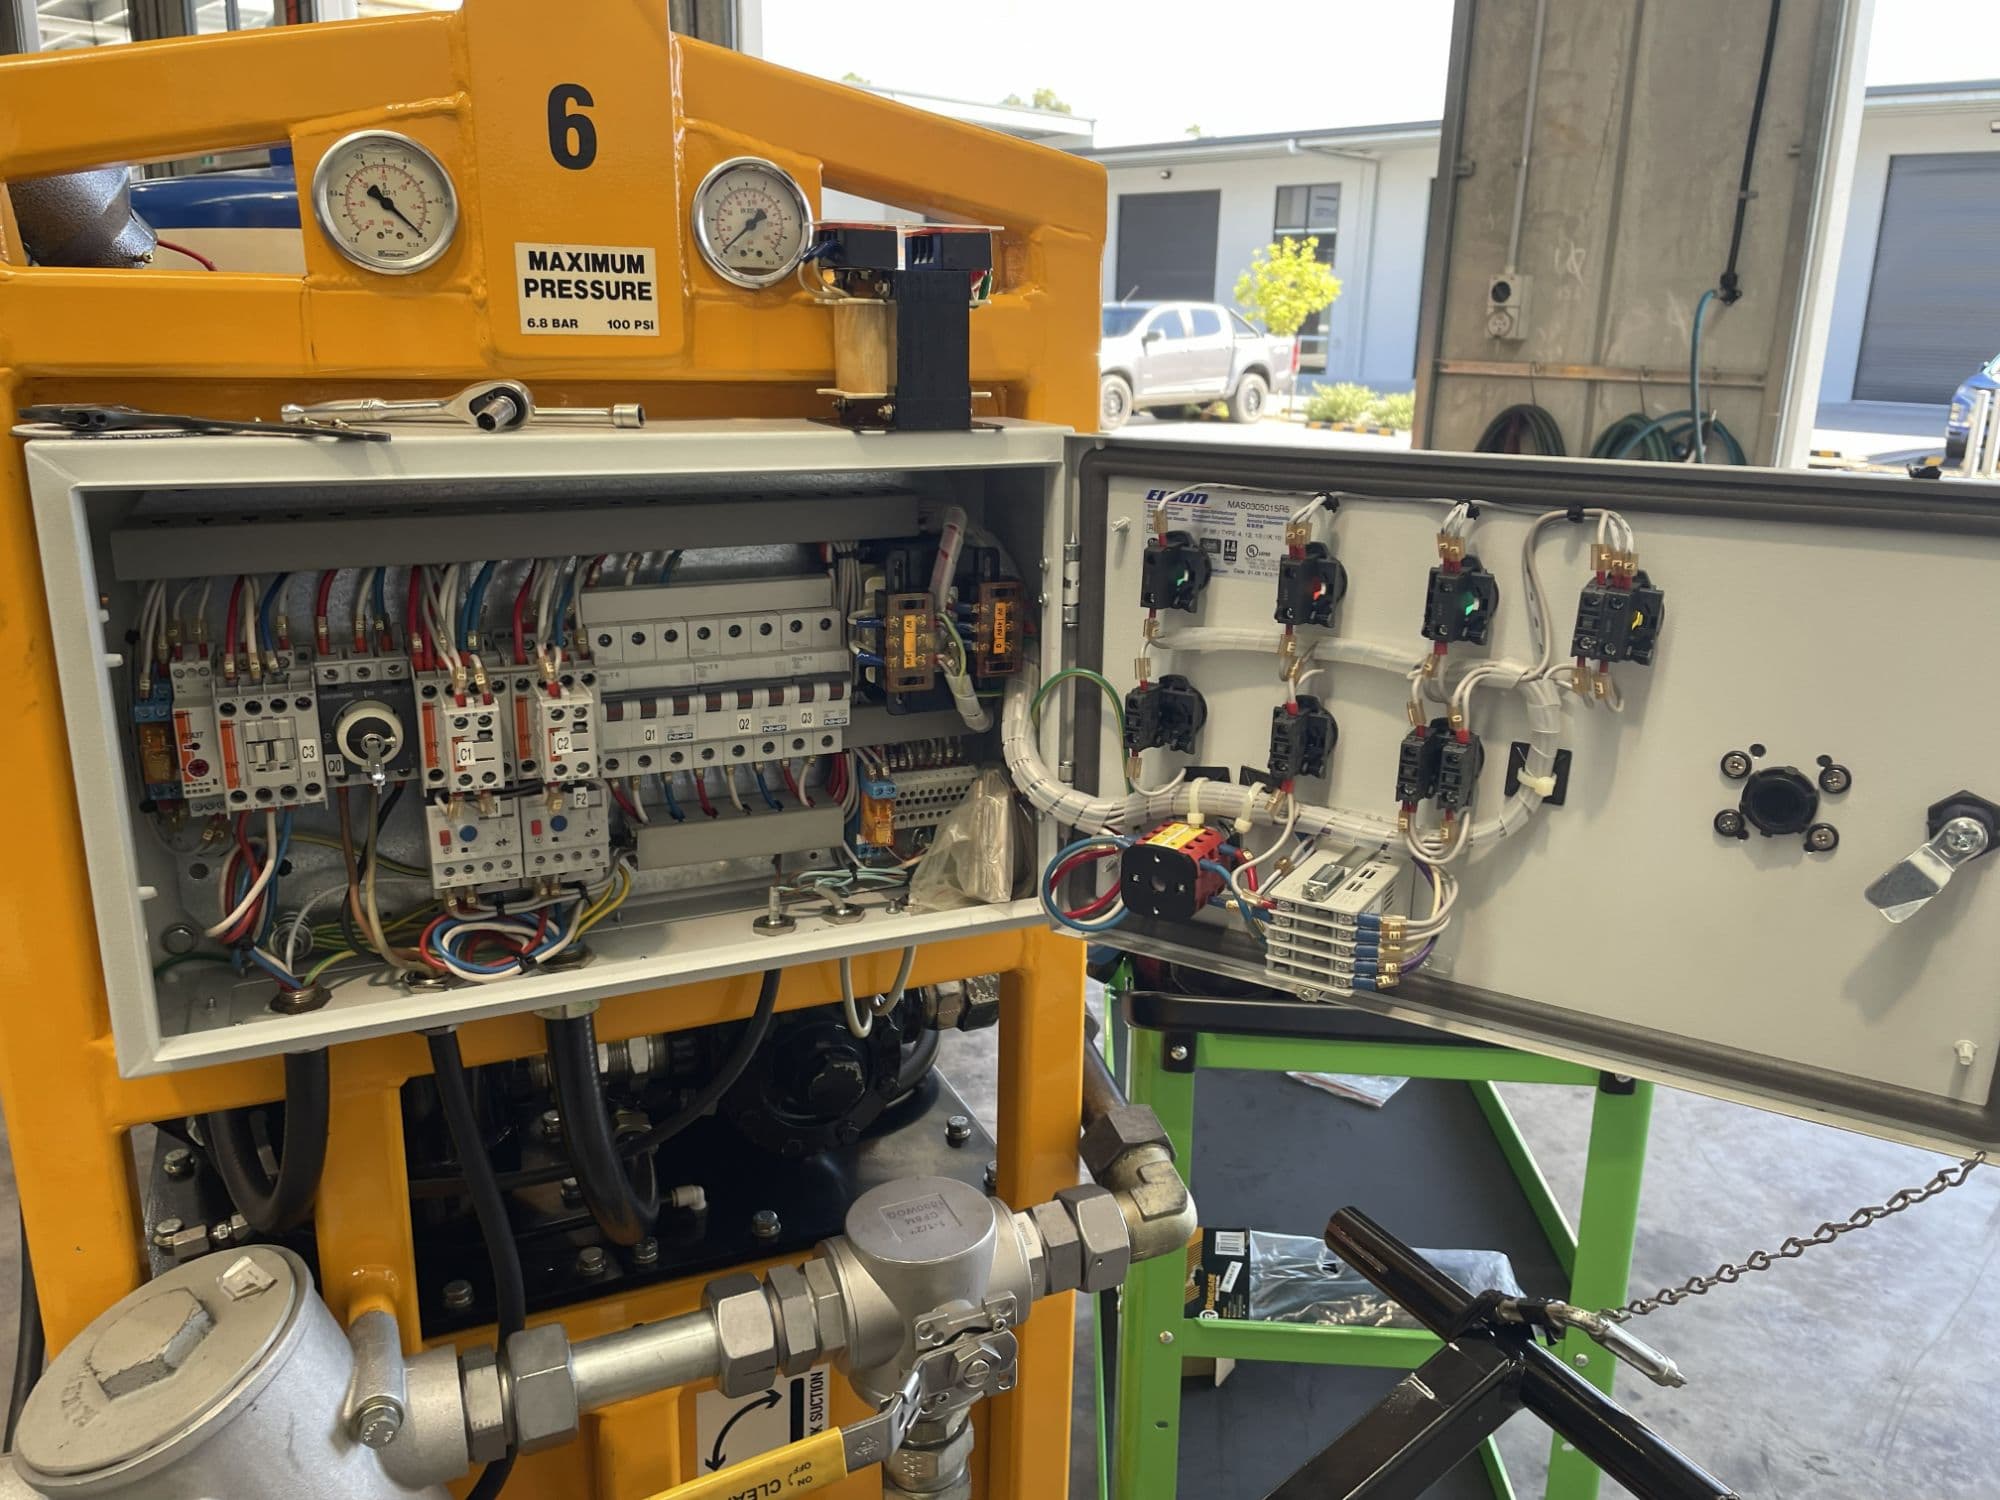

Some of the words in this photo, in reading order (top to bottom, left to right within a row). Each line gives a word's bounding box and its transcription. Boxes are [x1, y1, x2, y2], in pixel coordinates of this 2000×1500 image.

[548, 84, 597, 170] 6
[528, 251, 645, 274] MAXIMUM
[524, 278, 652, 301] PRESSURE
[527, 318, 548, 329] 6.8
[552, 319, 578, 329] BAR
[607, 320, 630, 330] 100
[634, 320, 654, 330] PSI
[739, 718, 750, 730] Q2
[801, 712, 812, 724] Q3
[645, 729, 655, 741] Q1
[557, 737, 569, 750] C2
[302, 745, 315, 759] C3
[460, 748, 472, 761] C1
[575, 793, 587, 805] F2
[810, 1371, 824, 1423] SUCTION
[793, 1461, 812, 1474] OFF
[797, 1475, 813, 1486] ON
[728, 1478, 781, 1500] CLEA
